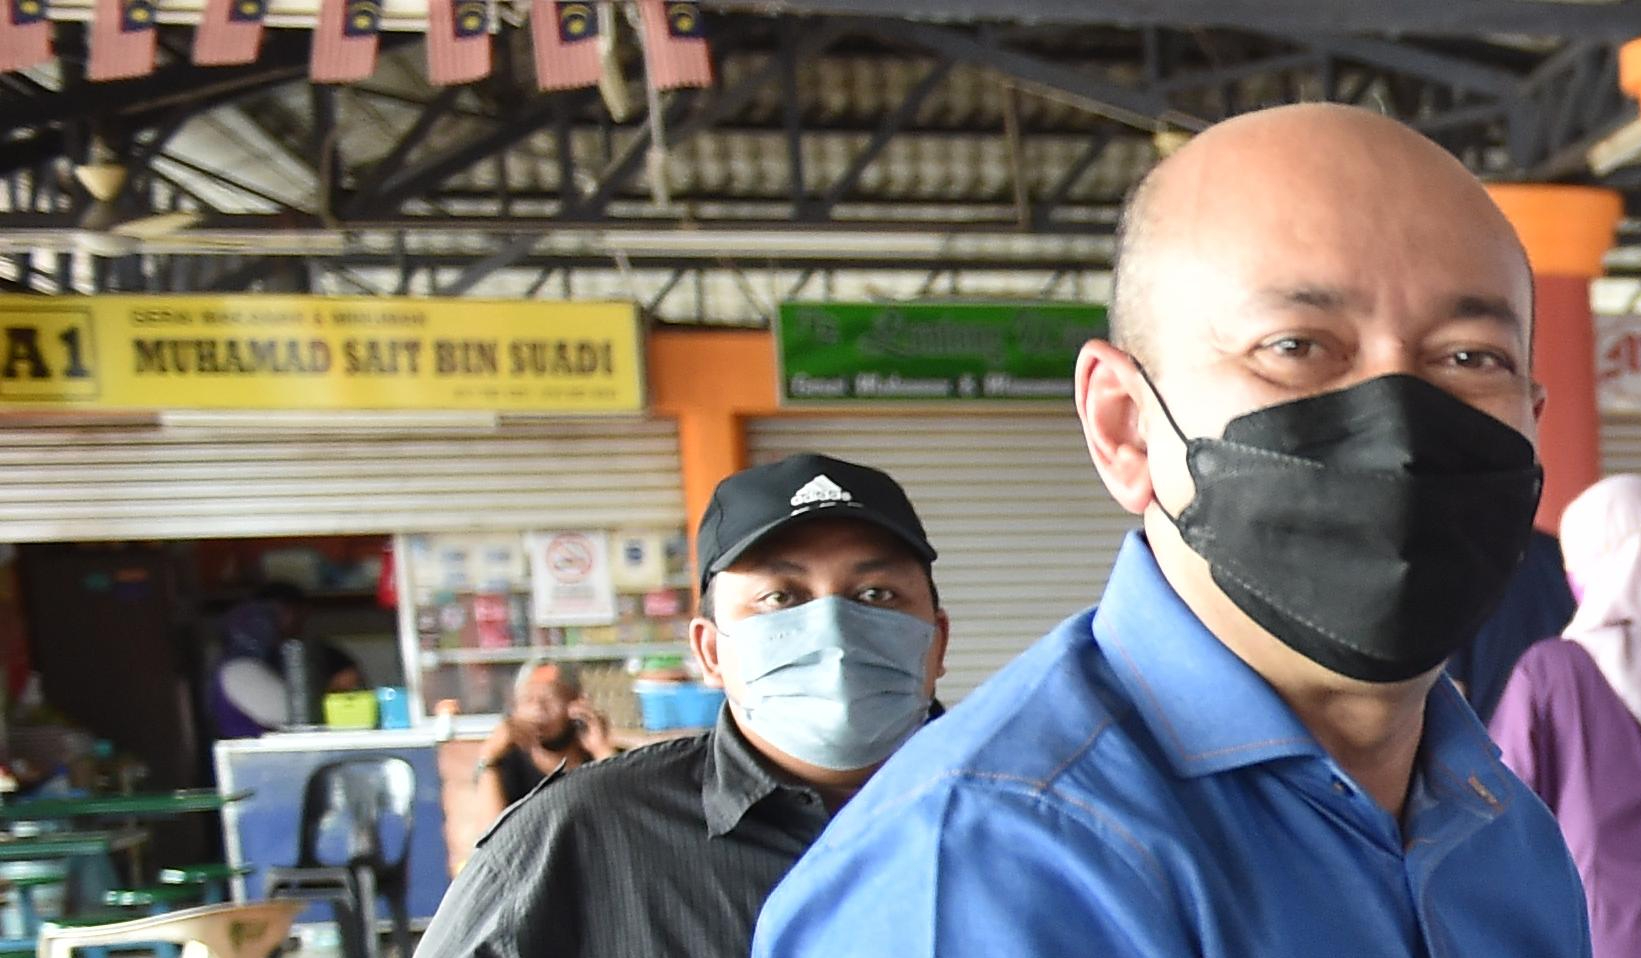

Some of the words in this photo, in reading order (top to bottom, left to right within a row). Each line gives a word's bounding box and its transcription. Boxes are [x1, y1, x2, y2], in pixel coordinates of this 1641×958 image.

[132, 338, 332, 374] MUHAMAD
[343, 339, 421, 374] SAIT
[434, 340, 498, 375] BIN
[508, 340, 613, 375] SUADI
